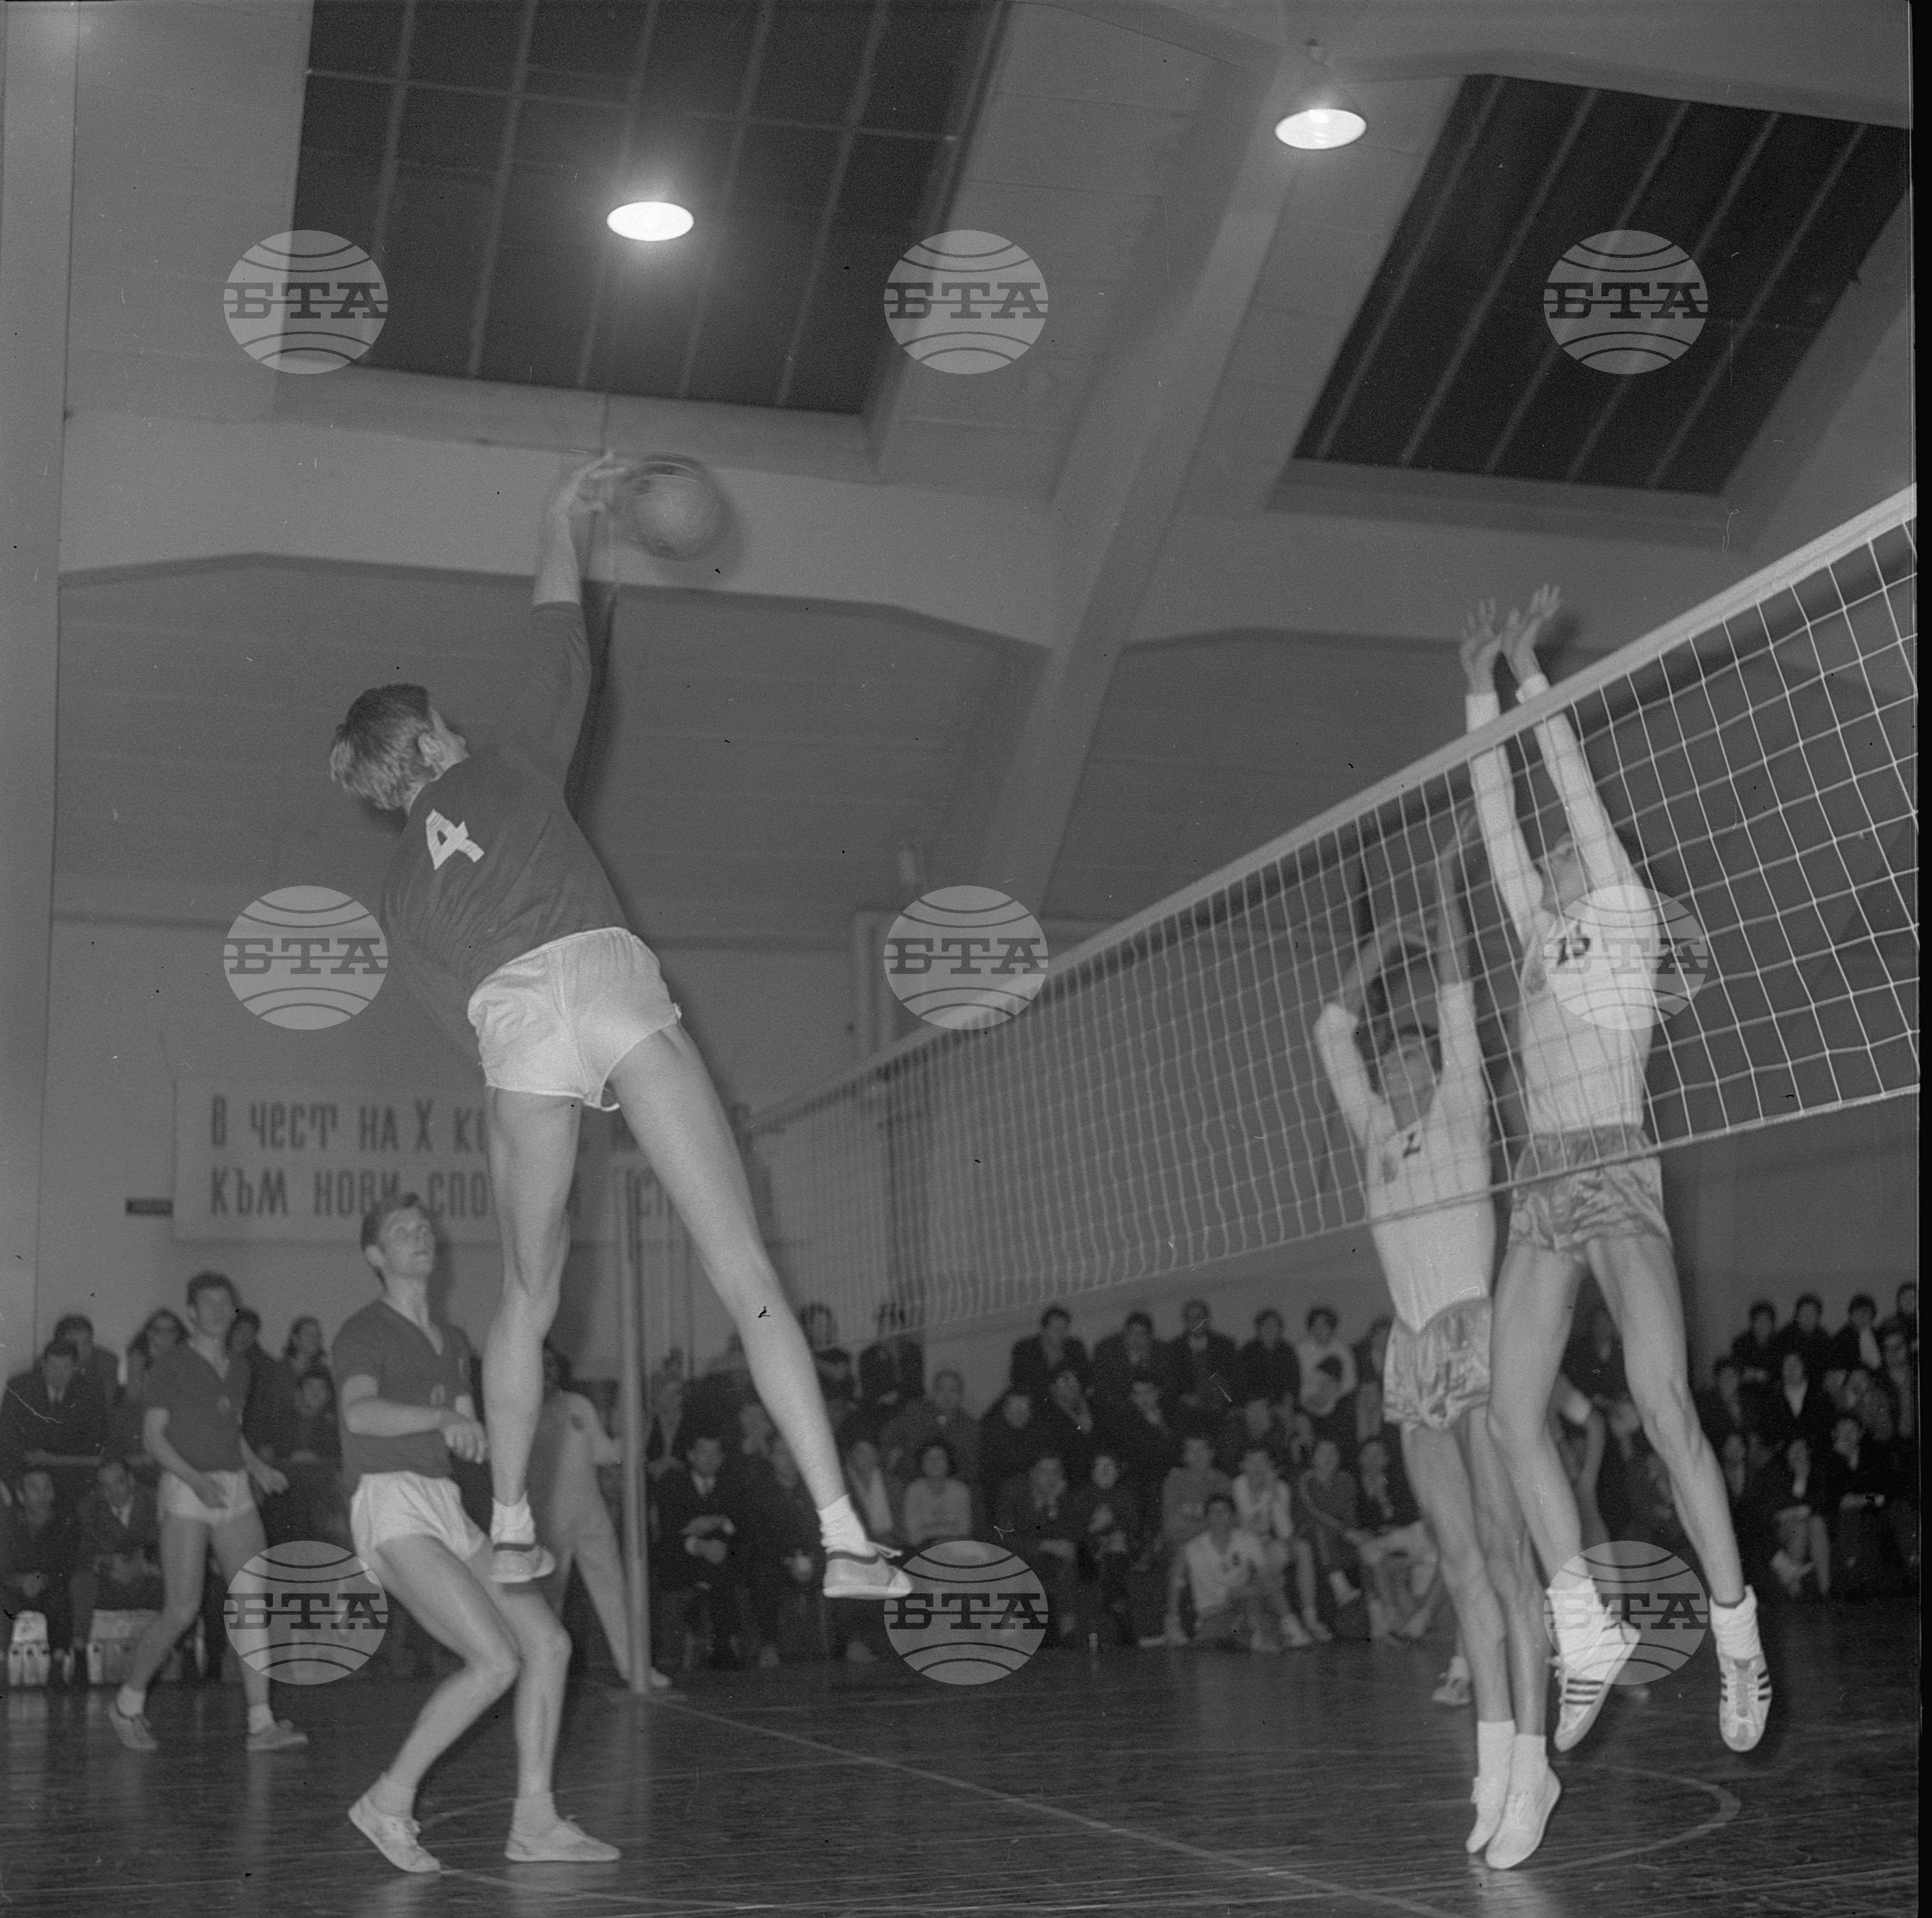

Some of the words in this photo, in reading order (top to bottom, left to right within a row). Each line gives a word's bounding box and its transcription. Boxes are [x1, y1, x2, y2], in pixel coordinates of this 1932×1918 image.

[425, 808, 484, 870] 4
[359, 1104, 399, 1153] НА
[211, 1166, 288, 1216] КЪМ
